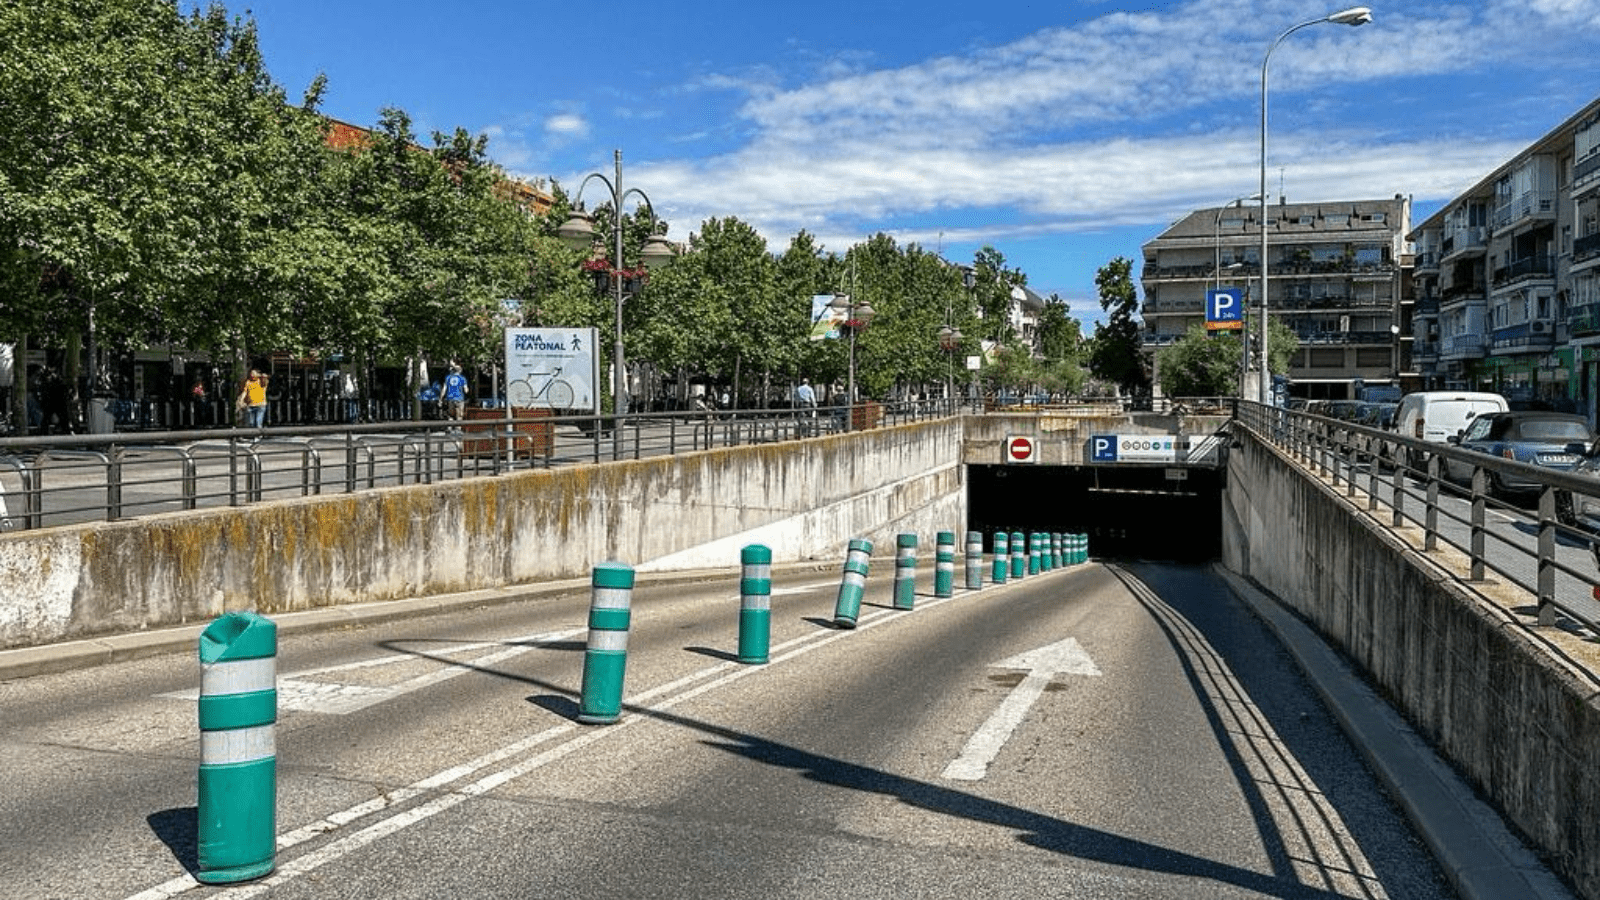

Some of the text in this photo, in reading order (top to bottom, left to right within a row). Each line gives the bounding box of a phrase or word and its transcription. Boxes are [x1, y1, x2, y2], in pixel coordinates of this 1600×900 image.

[1215, 293, 1233, 318] P
[515, 334, 542, 342] ZONA
[1095, 439, 1109, 456] P
